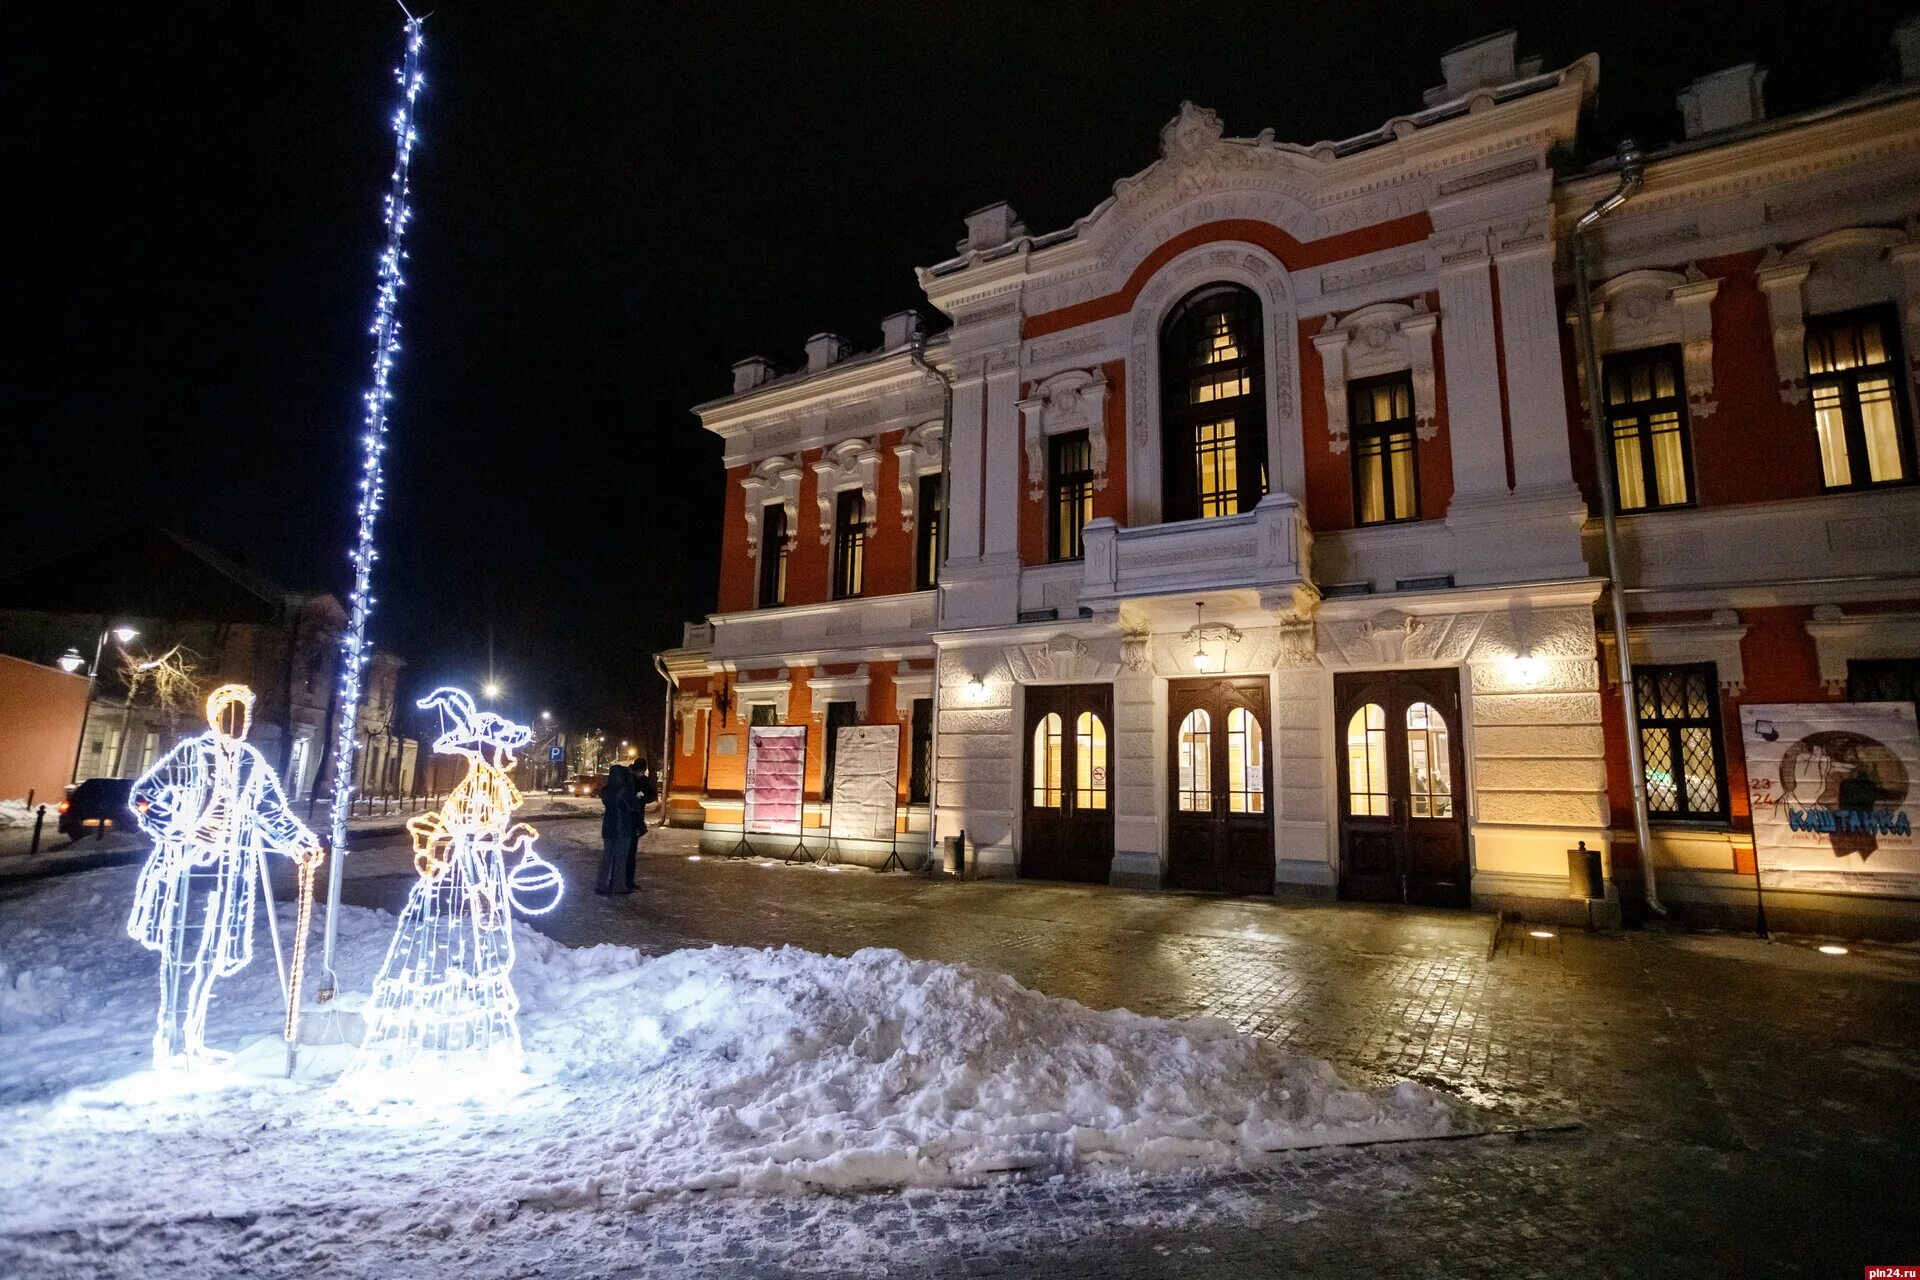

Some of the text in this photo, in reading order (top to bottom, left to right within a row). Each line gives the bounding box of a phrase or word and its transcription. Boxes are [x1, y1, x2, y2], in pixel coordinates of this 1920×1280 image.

[1751, 778, 1771, 789] 23
[1753, 793, 1773, 805] 24
[1789, 809, 1911, 836] КАШТАНКА
